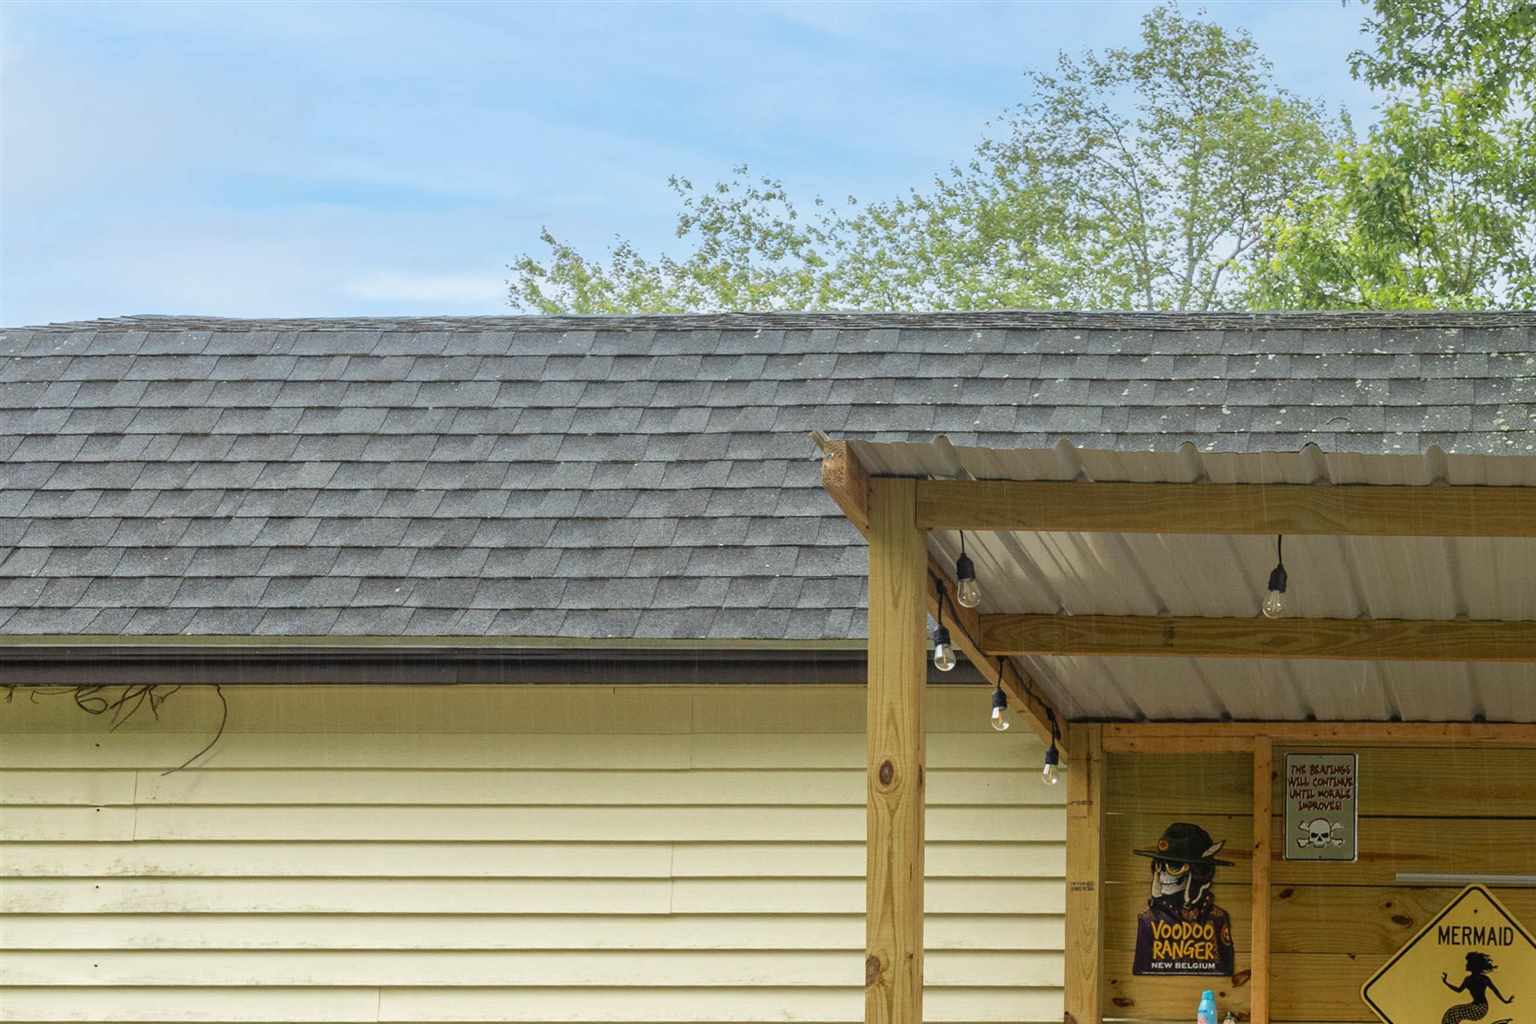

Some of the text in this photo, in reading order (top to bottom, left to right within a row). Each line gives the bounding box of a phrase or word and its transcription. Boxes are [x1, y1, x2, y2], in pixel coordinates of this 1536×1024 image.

[1290, 764, 1306, 775] THE
[1288, 776, 1353, 787] WILL CONTINUE
[1289, 788, 1351, 799] UNTIL MORALE
[1151, 920, 1214, 940] VOODOO
[1438, 926, 1514, 946] MERMAID
[1152, 939, 1215, 960] RANGER
